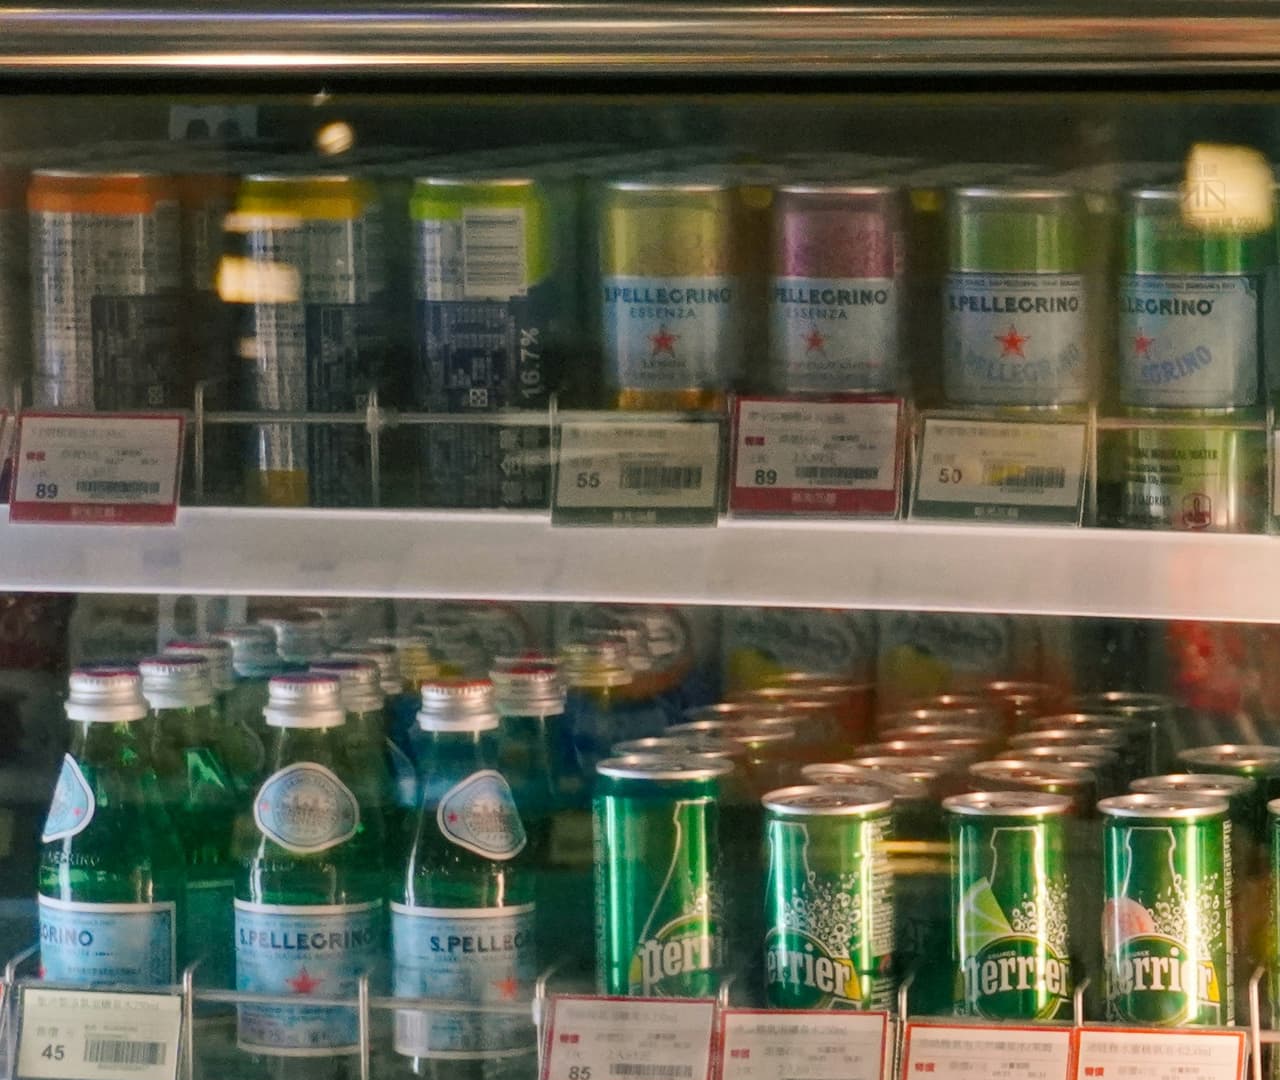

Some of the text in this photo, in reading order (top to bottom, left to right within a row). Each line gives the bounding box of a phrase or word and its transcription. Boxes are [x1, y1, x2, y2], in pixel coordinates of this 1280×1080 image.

[520, 327, 541, 399] 16.7%
[576, 472, 600, 489] 55
[754, 469, 778, 485] 89
[937, 467, 963, 485] 50
[36, 482, 59, 499] 89
[40, 1043, 66, 1061] 45
